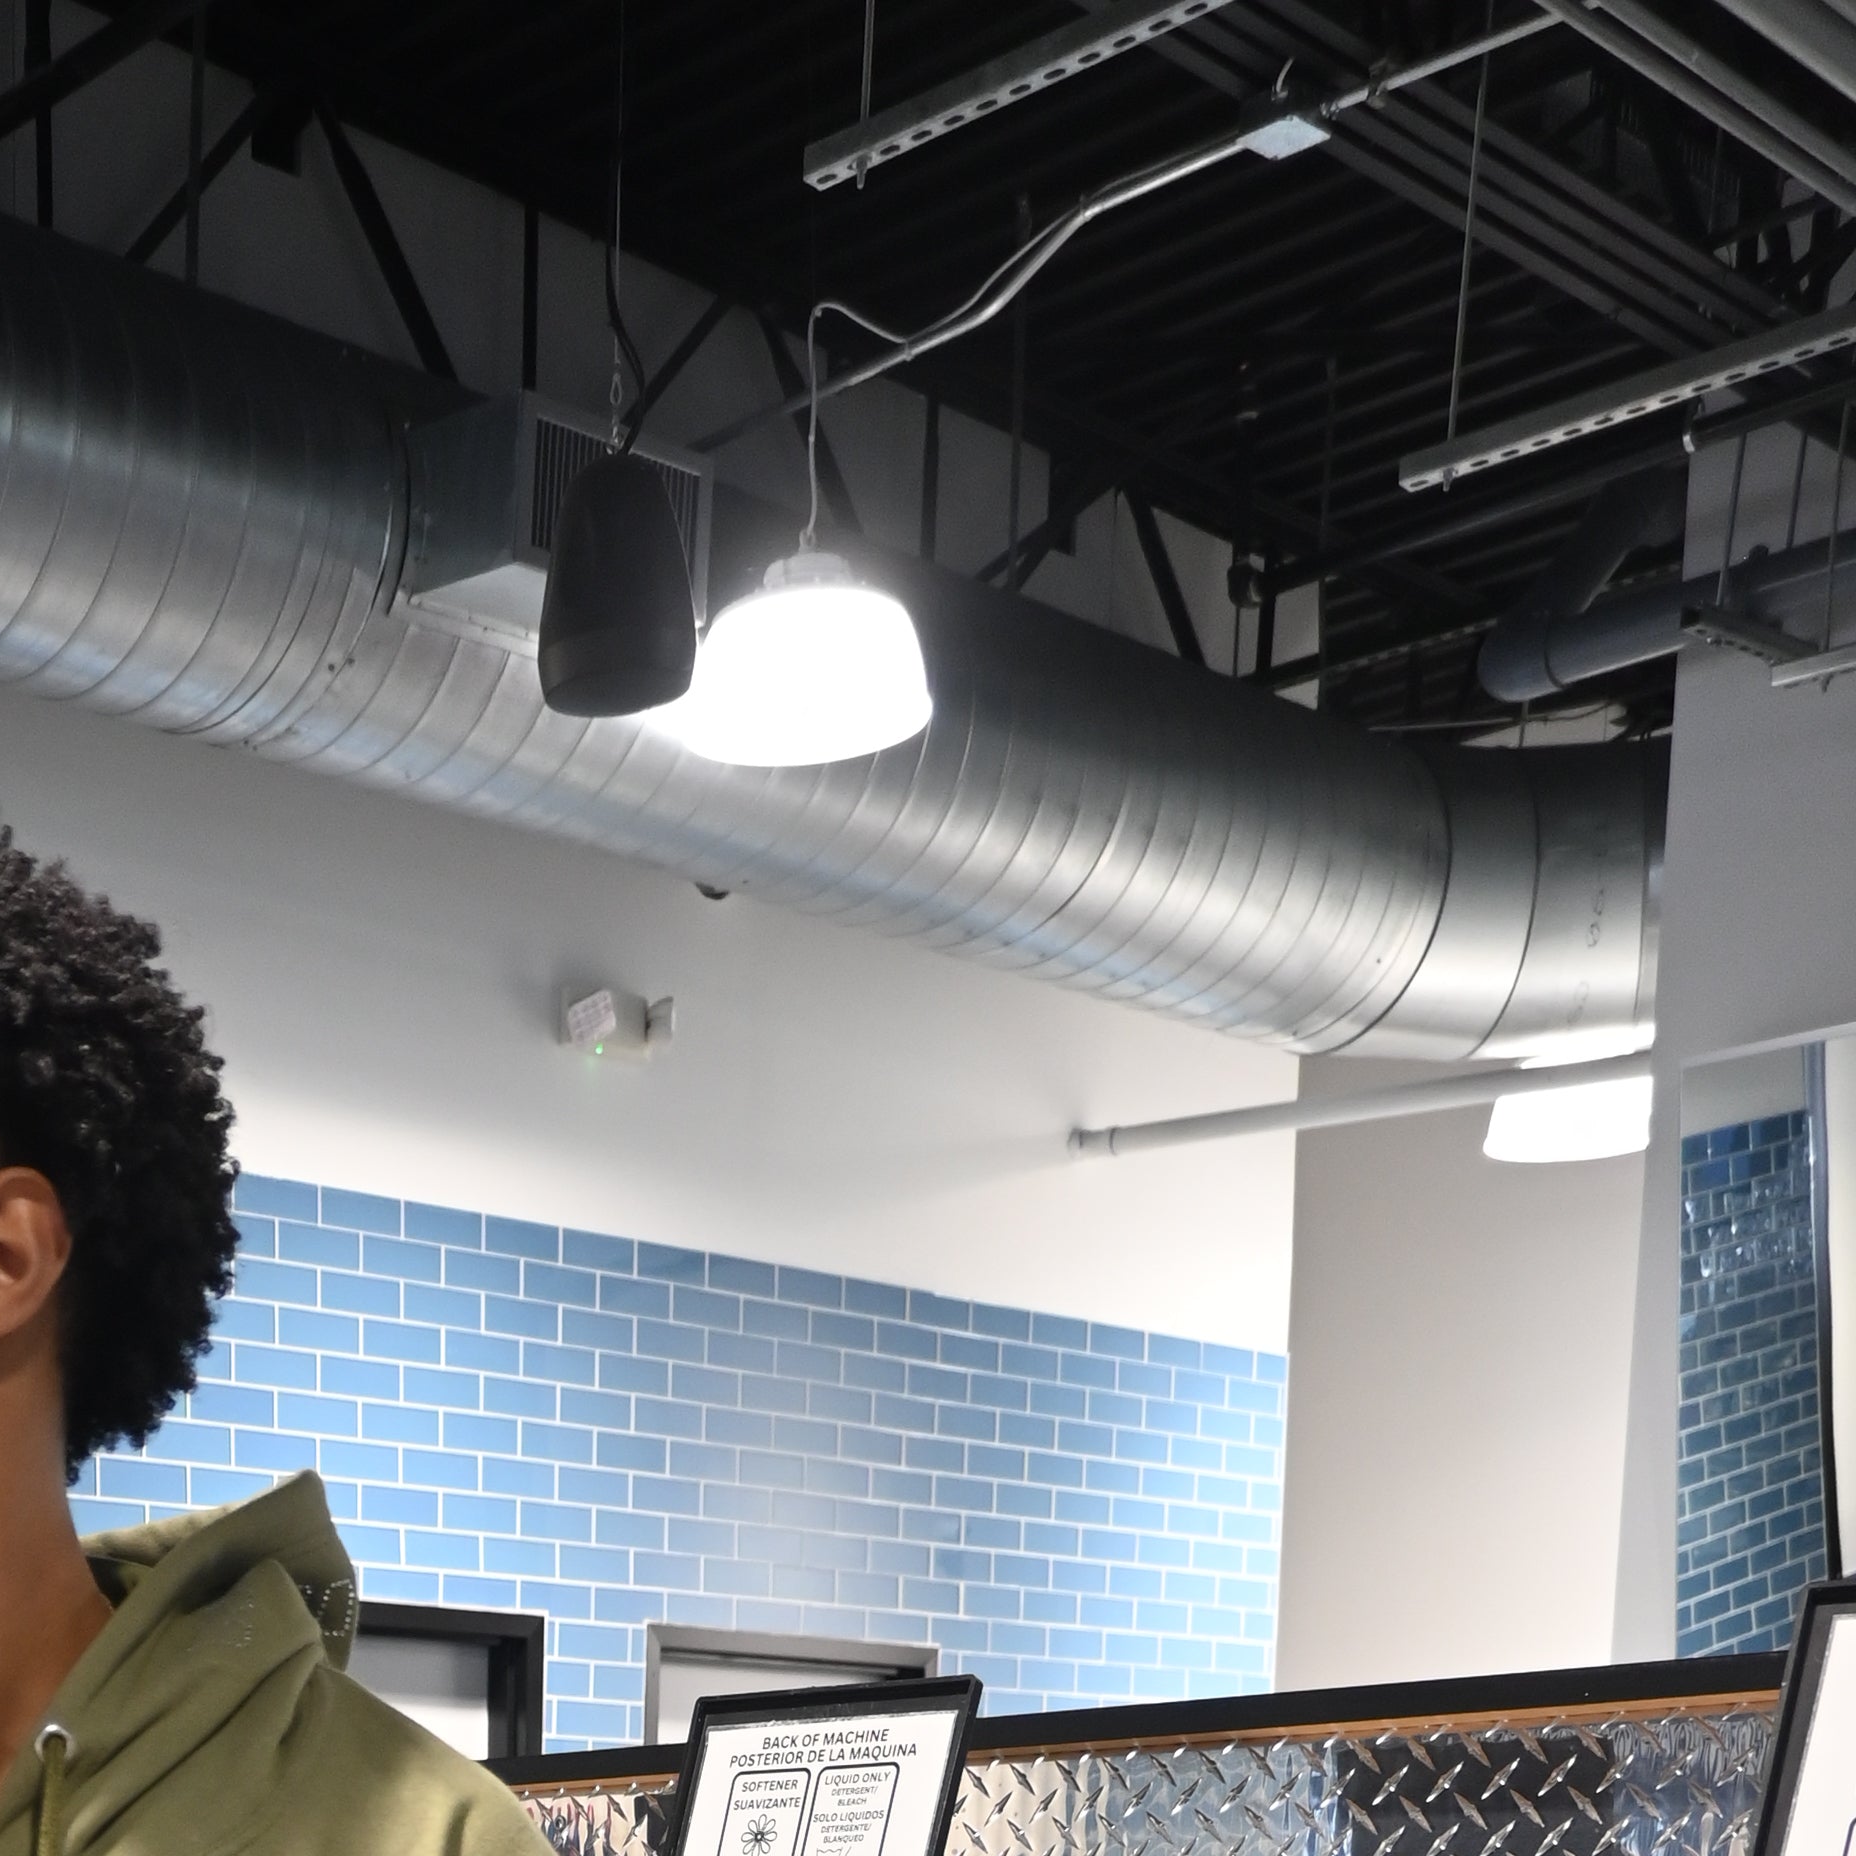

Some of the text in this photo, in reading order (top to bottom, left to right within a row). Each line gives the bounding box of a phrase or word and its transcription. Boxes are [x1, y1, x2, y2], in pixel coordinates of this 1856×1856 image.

[762, 1729, 890, 1750] BACK OF MACHINE
[729, 1743, 917, 1768] POSTERIOR DE LA MAQUINA
[824, 1771, 891, 1786] LIQUID ONLY
[742, 1779, 799, 1792] SOFTENER
[733, 1797, 801, 1811] SUAVIZANTE
[837, 1798, 867, 1807] BLEACH
[813, 1810, 885, 1823] SOLO LIQUIDOS
[823, 1834, 865, 1844] BLANQUEO
